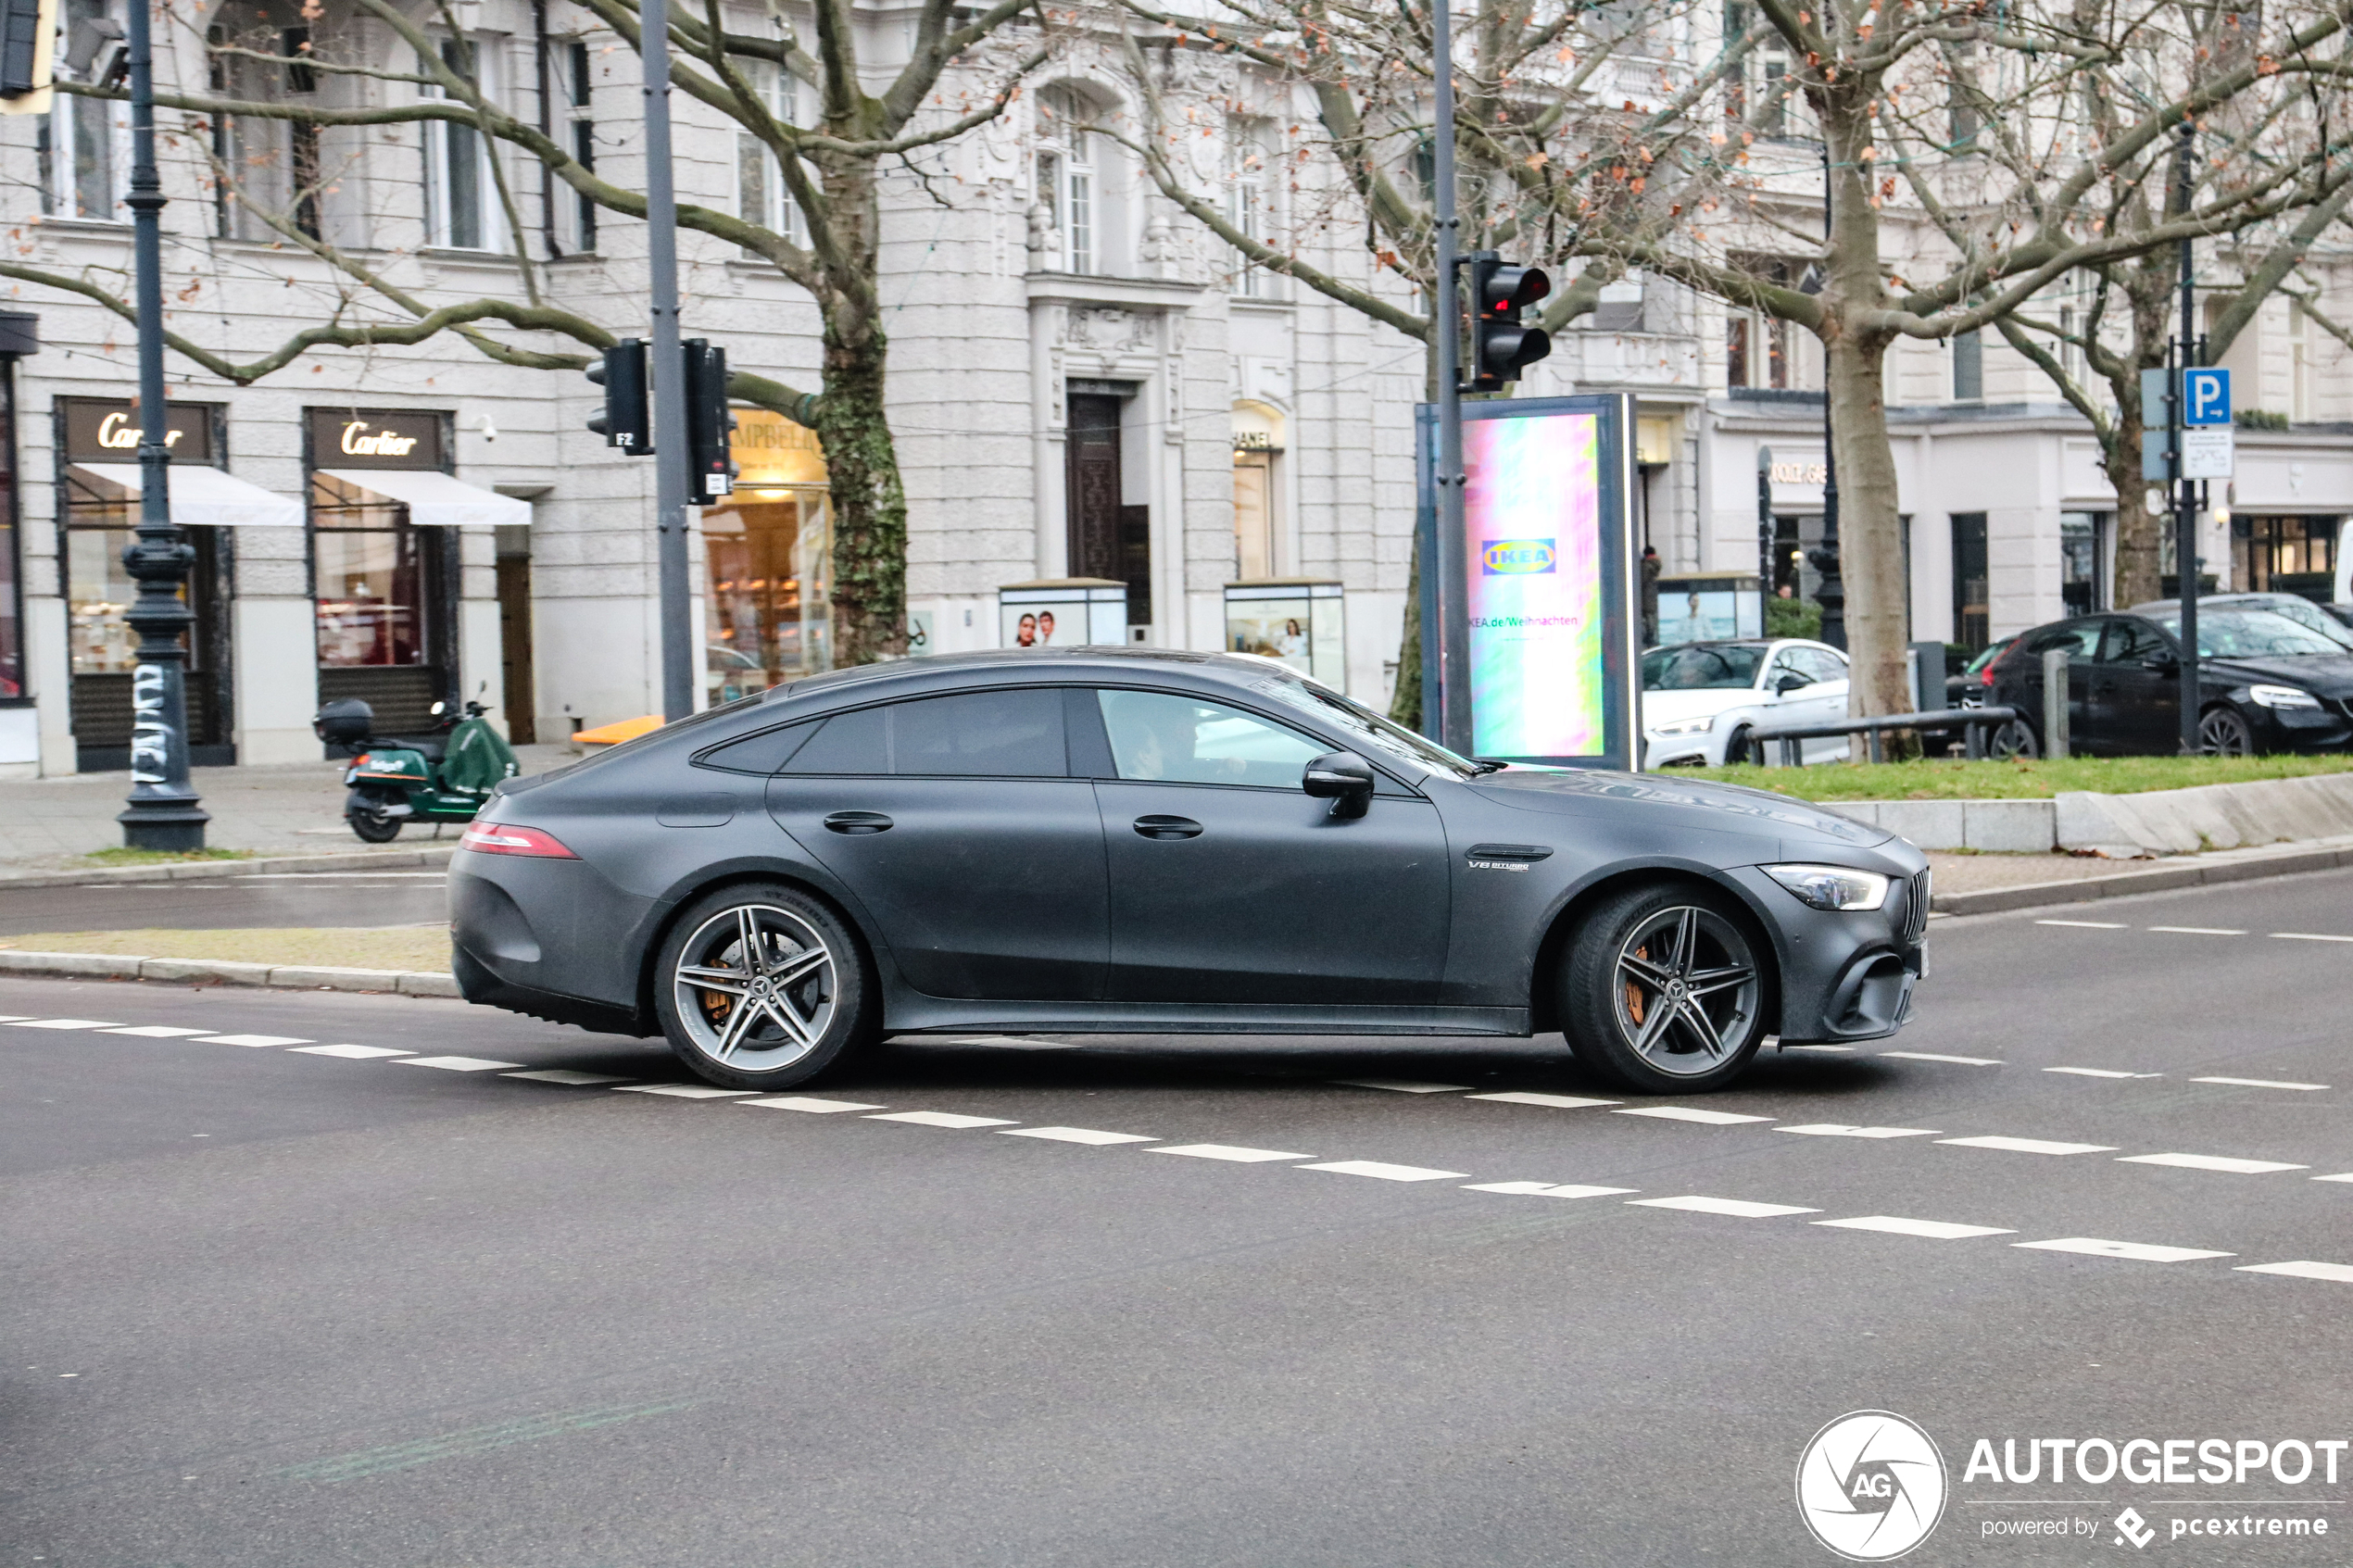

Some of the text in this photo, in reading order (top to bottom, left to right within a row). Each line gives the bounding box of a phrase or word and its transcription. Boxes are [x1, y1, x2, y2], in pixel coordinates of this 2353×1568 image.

[2195, 375, 2221, 419] P
[97, 411, 183, 448] Carr
[341, 420, 418, 456] Cartier
[615, 433, 634, 446] F2
[1490, 548, 1551, 565] IKEA
[1468, 616, 1578, 628] KEA.de/Weihnachten
